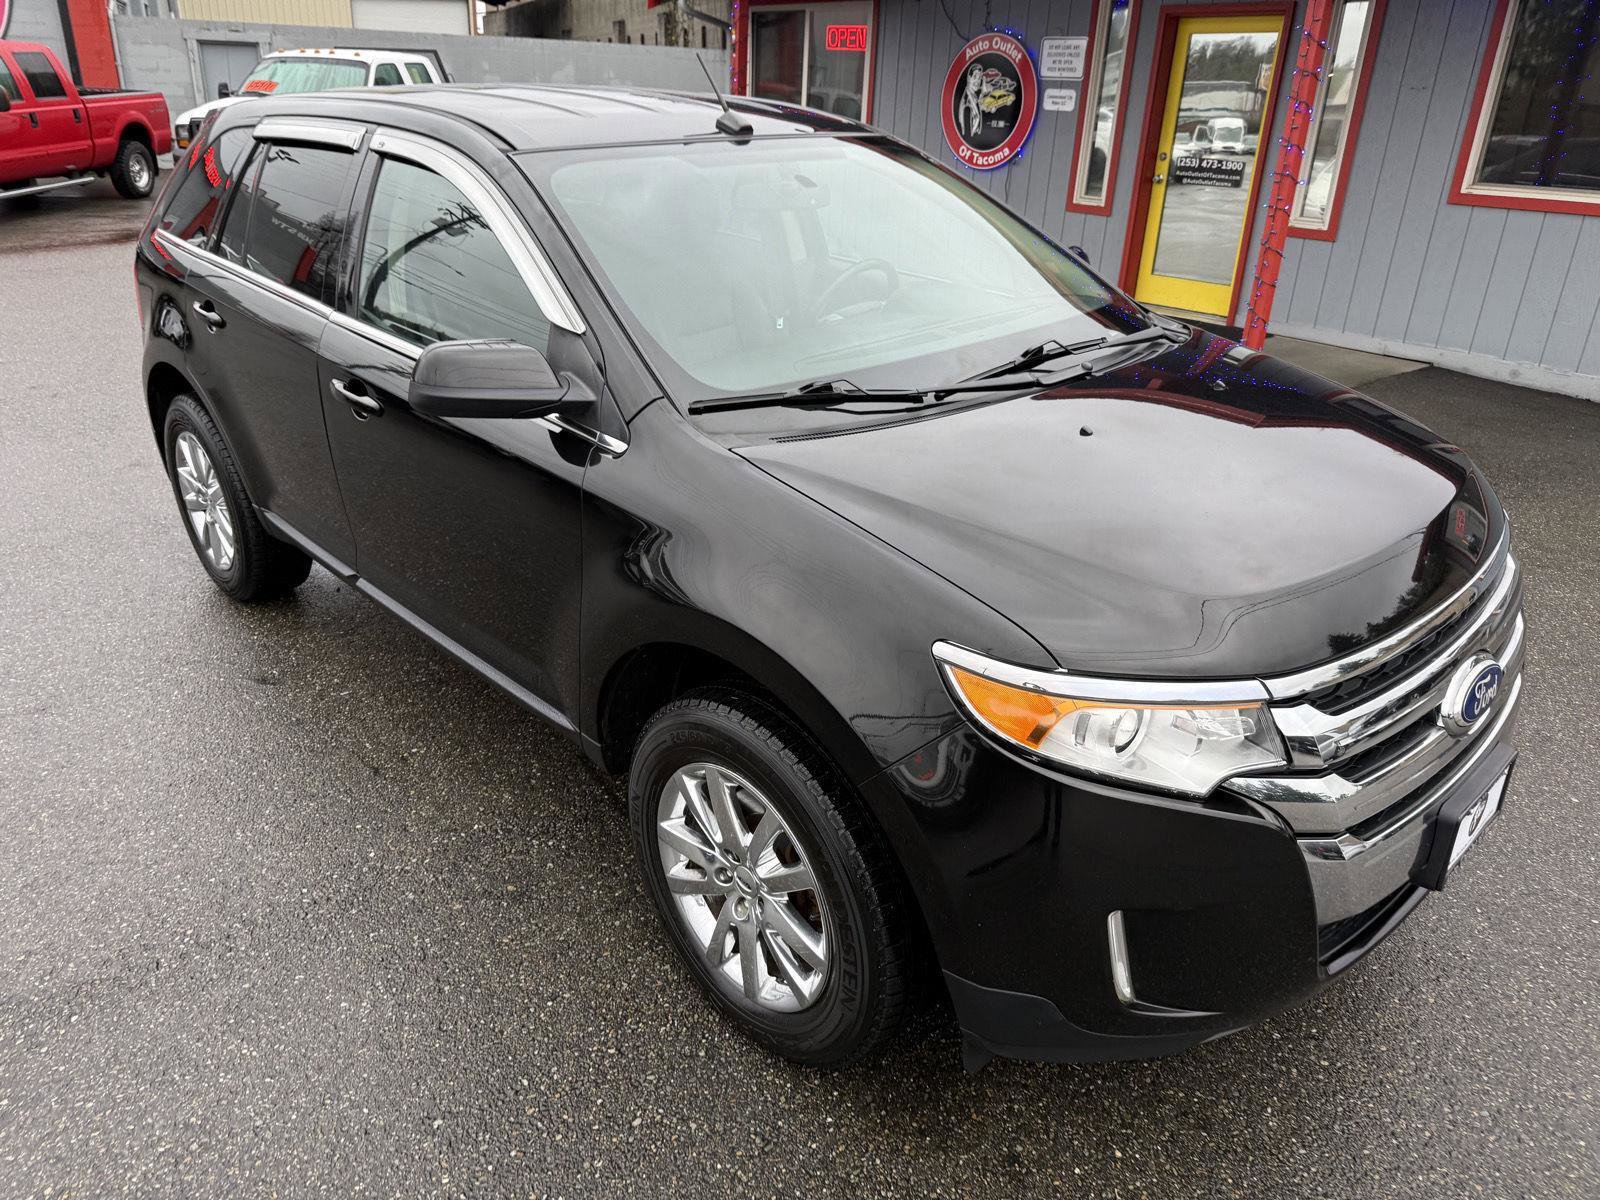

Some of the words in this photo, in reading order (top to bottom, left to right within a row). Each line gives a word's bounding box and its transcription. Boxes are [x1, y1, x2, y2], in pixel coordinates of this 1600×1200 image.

[828, 28, 866, 48] OPEN
[965, 40, 990, 61] Auto
[992, 36, 1022, 63] Outlet
[959, 145, 971, 160] Of
[972, 147, 1010, 165] Tacoma
[1177, 157, 1199, 168] (253)
[1201, 159, 1243, 171] 473-1900
[1474, 672, 1498, 715] Ford
